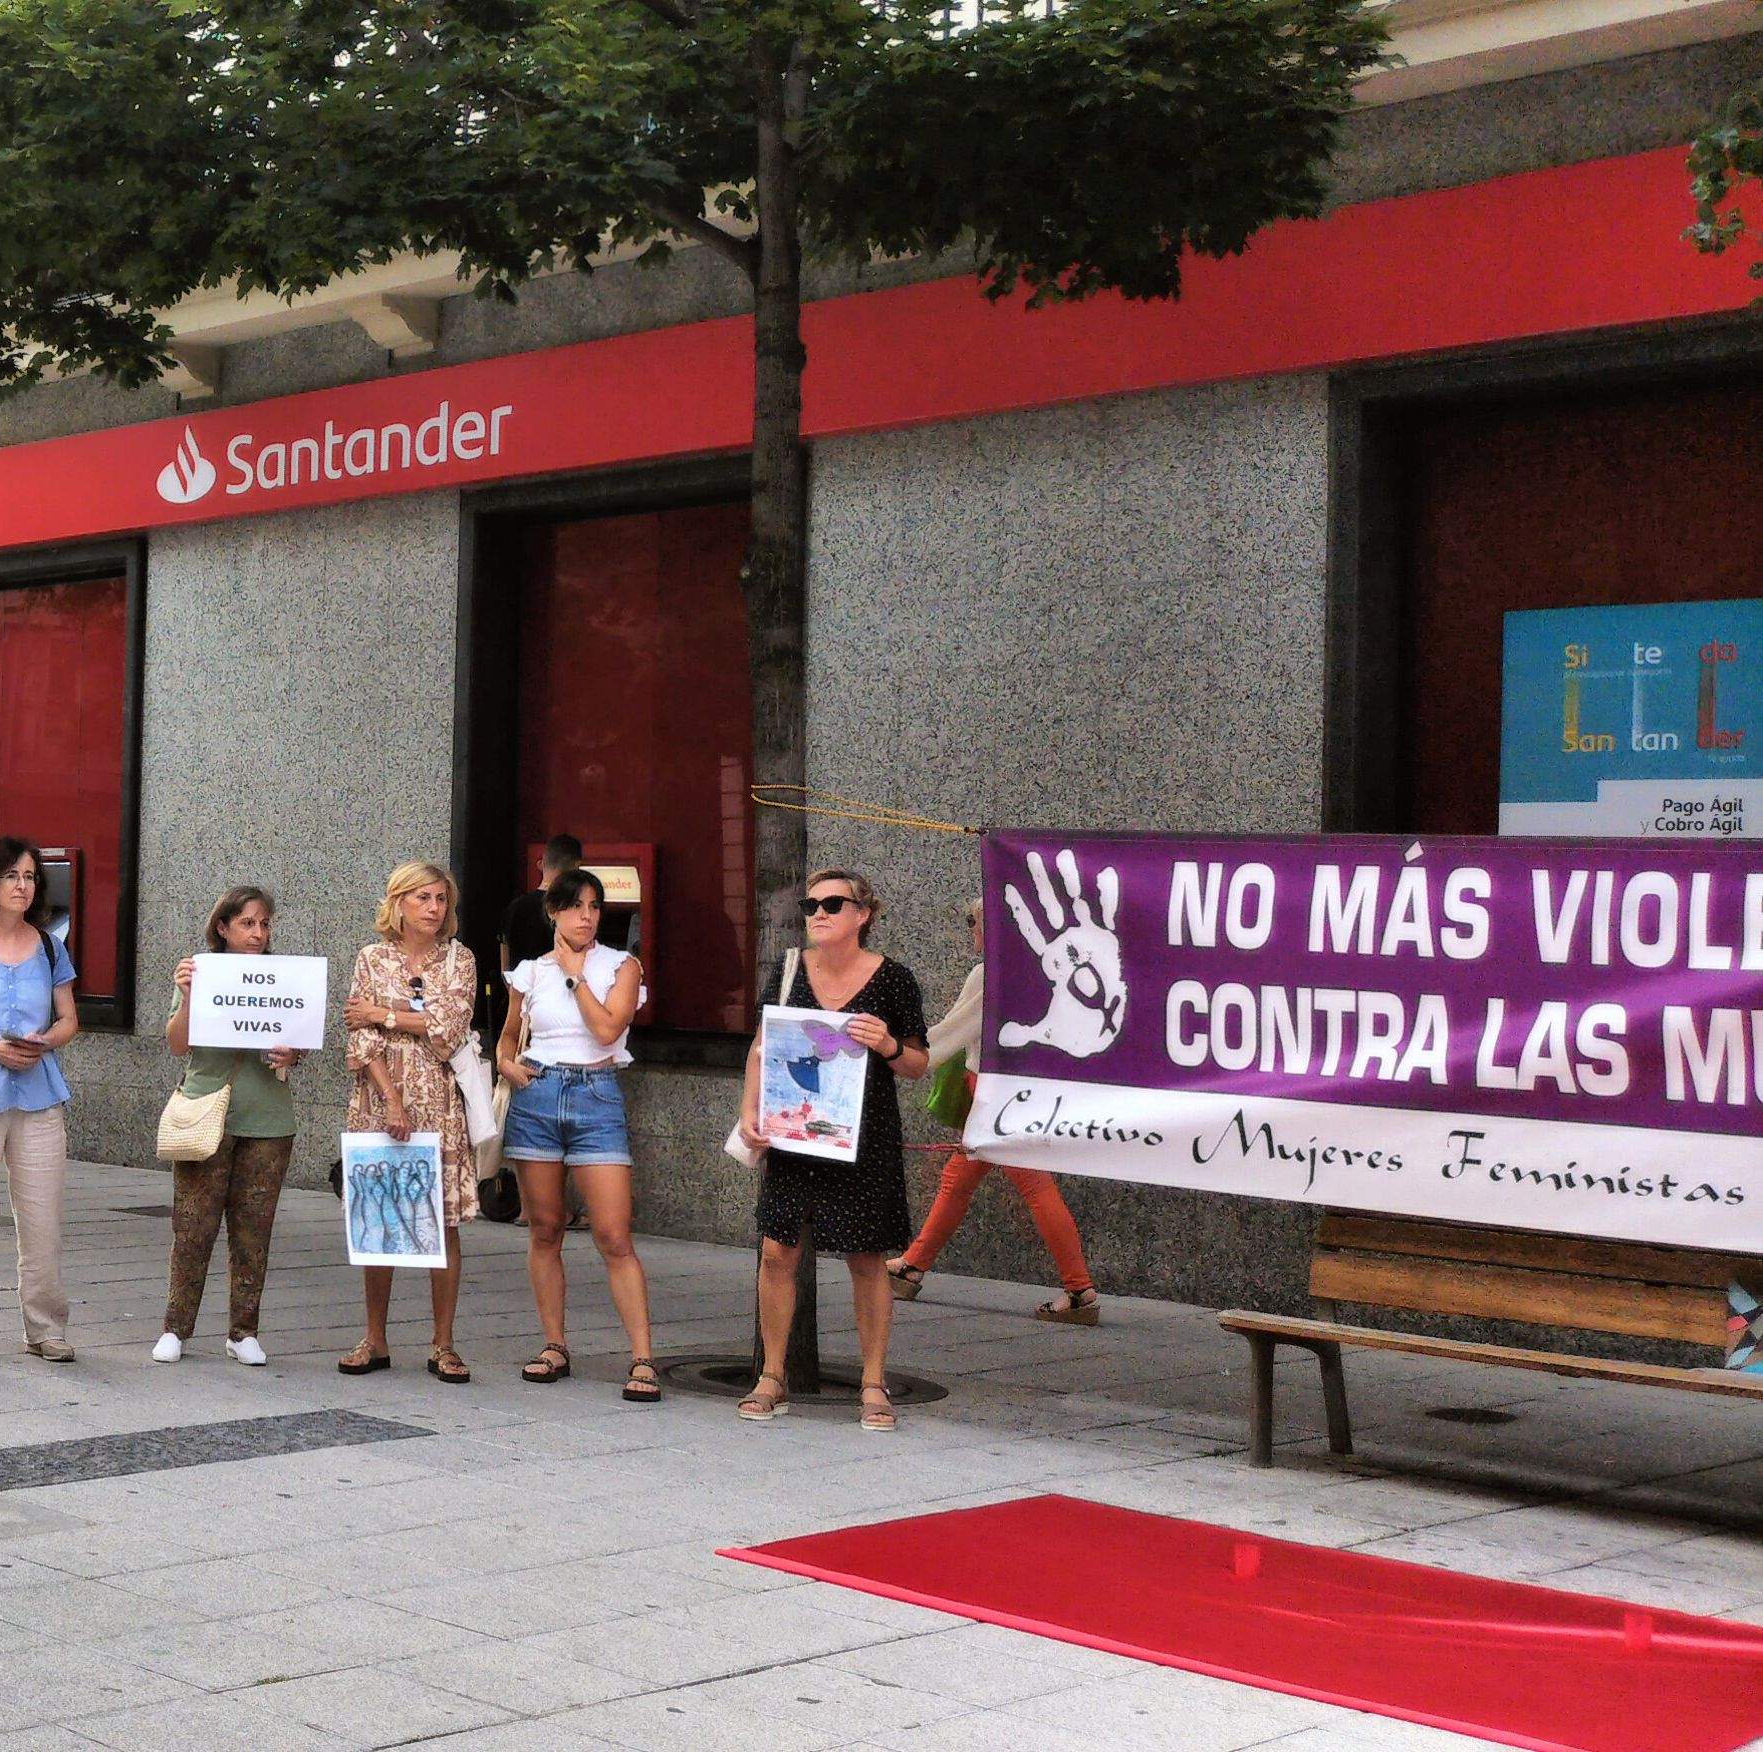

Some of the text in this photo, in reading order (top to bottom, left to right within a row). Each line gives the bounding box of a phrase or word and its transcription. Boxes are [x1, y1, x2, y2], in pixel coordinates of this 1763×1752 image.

[225, 400, 513, 495] Santander
[1634, 642, 1663, 665] te
[1662, 795, 1744, 815] Pago Ágil
[1640, 813, 1743, 835] y Cobro Ágil
[1167, 861, 1276, 950] NO
[1308, 840, 1491, 960] MÁS
[242, 972, 276, 985] NOS
[212, 994, 305, 1009] QUEREMOS
[233, 1020, 283, 1033] VIVAS
[1166, 980, 1448, 1085] CONTRA
[1476, 996, 1630, 1097] LAS
[994, 1089, 1745, 1205] Colectivo Mujeres Feministas
